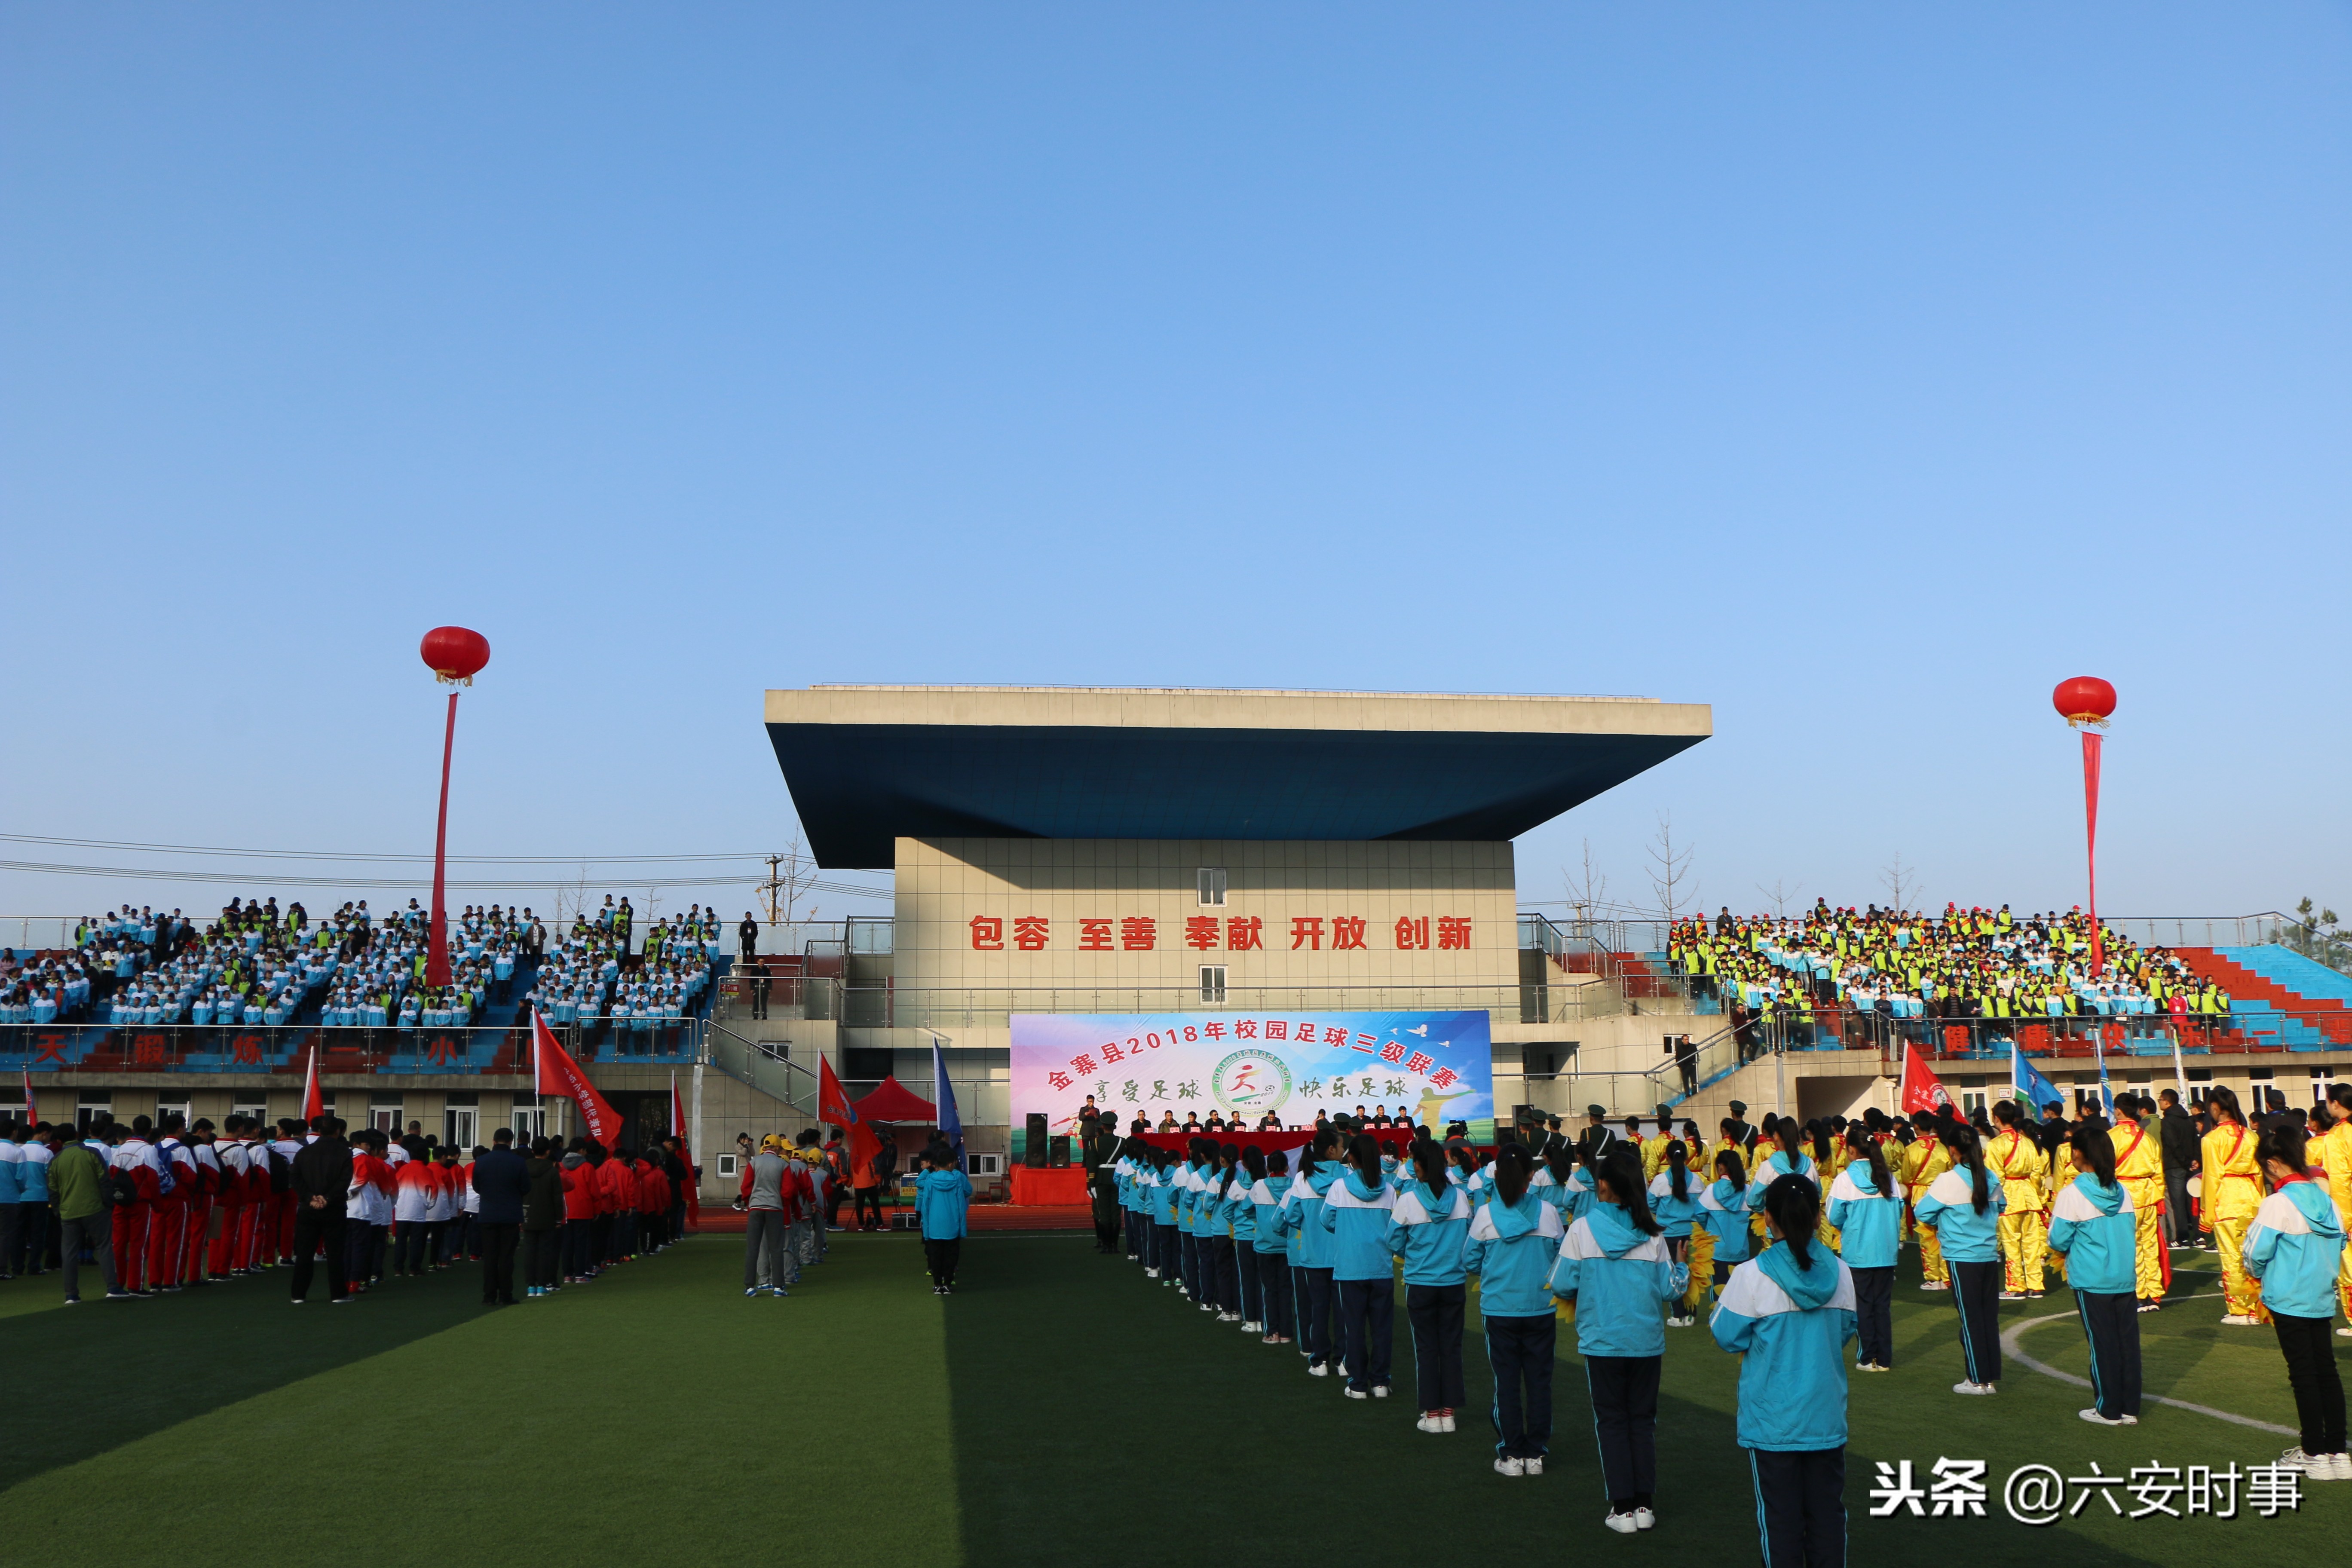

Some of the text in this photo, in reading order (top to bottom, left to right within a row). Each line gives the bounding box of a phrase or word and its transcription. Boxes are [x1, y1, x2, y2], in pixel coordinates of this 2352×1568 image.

[969, 915, 1472, 950] 包容 至善 奉献 开放 创新
[1047, 1020, 1459, 1091] 金寨县2018年校园足球三级联赛
[1094, 1076, 1409, 1103] 享受足球 快乐足球
